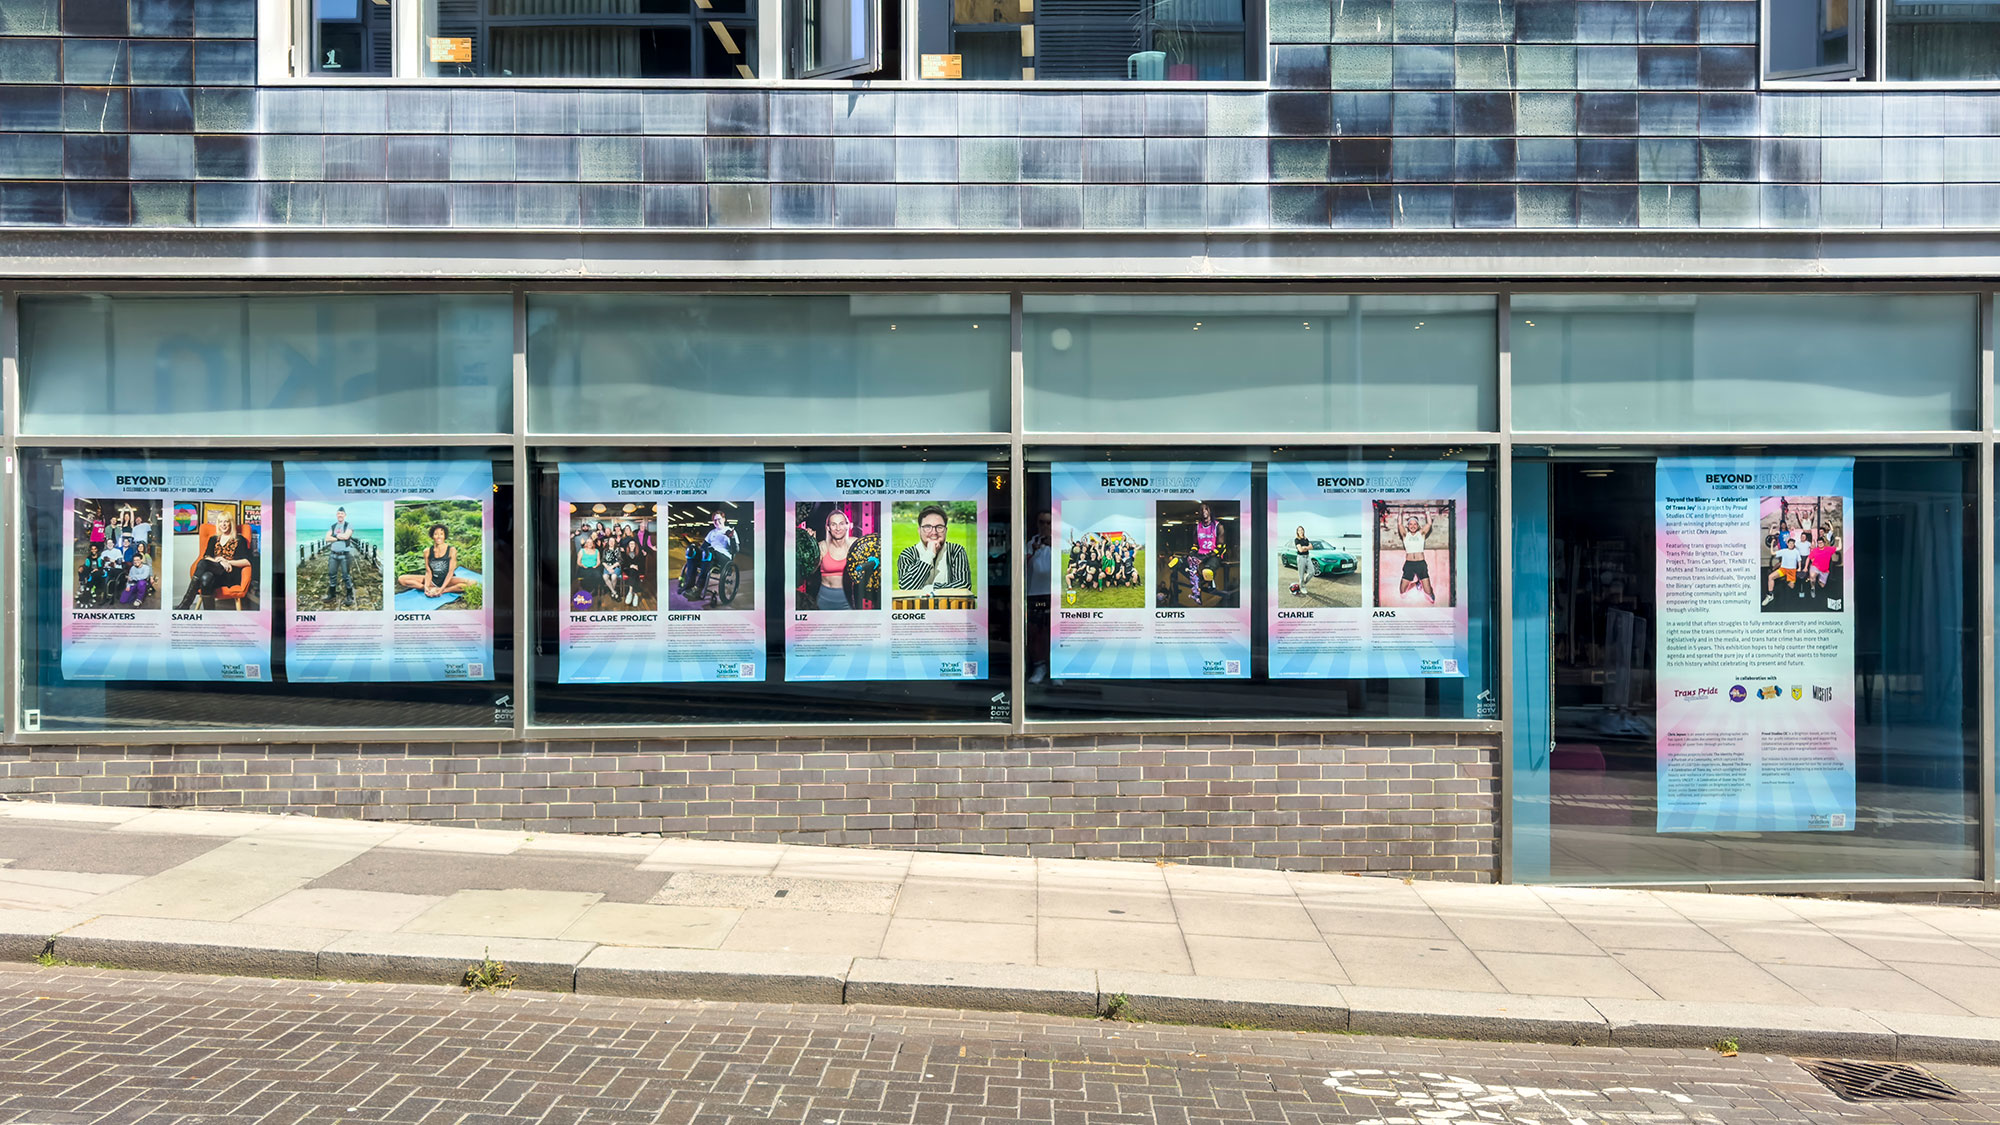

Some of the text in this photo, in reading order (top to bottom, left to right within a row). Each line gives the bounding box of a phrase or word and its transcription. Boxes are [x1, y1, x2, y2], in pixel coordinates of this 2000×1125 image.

[116, 476, 219, 486] BEYOND BINARY
[338, 477, 440, 486] BEYOND BINARY
[1101, 477, 1199, 487] BEYOND BINARY
[1317, 477, 1416, 486] BEYOND BINARY
[1706, 474, 1804, 483] BEYOND BINARY
[611, 479, 713, 488] BEYOND BINARY
[836, 479, 936, 488] BEYOND BINARY
[1202, 541, 1213, 549] 22
[1674, 688, 1696, 697] Trans
[1812, 685, 1832, 702] MISFITS
